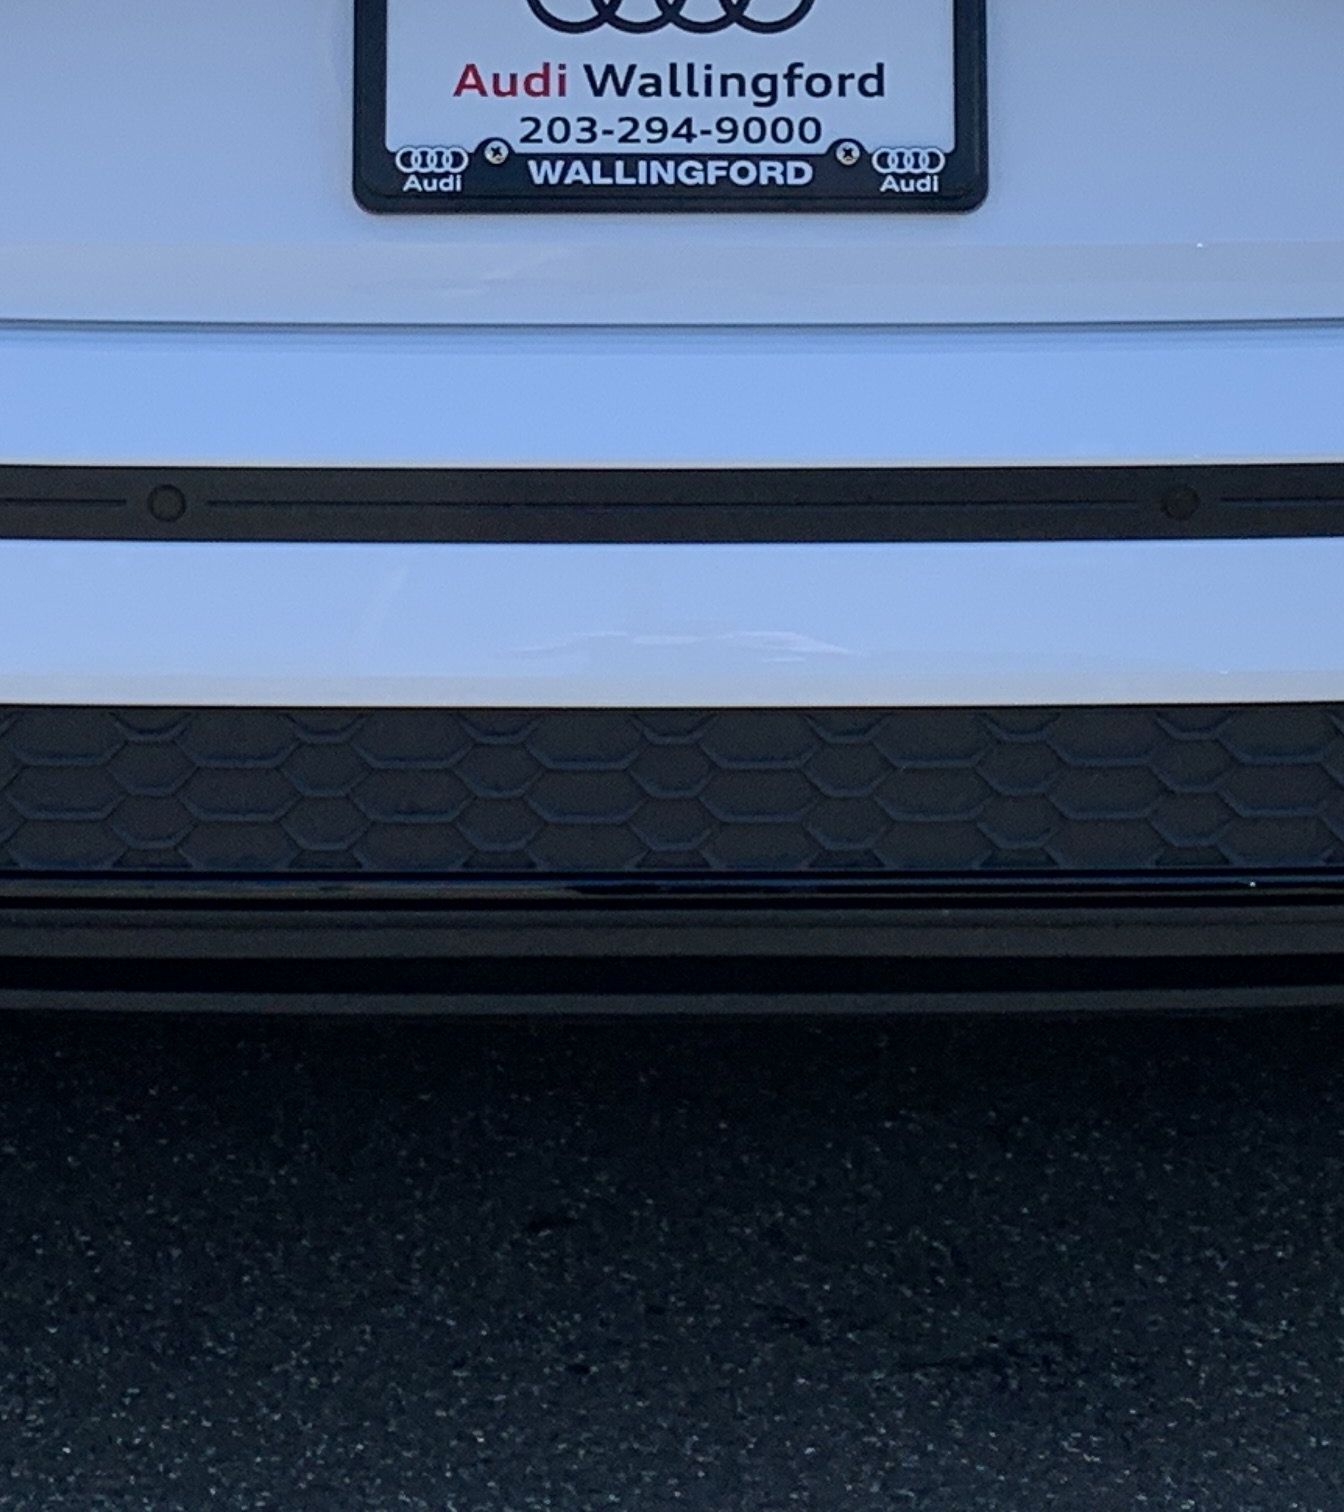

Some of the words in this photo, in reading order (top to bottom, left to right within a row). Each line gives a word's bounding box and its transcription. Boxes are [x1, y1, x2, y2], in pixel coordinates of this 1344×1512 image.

[453, 62, 567, 98] Audi
[583, 61, 886, 108] Wallingford
[519, 116, 823, 145] 203-294-9000
[402, 173, 463, 193] Audi
[527, 159, 814, 187] WALLINGFORD
[879, 174, 939, 193] Audi
